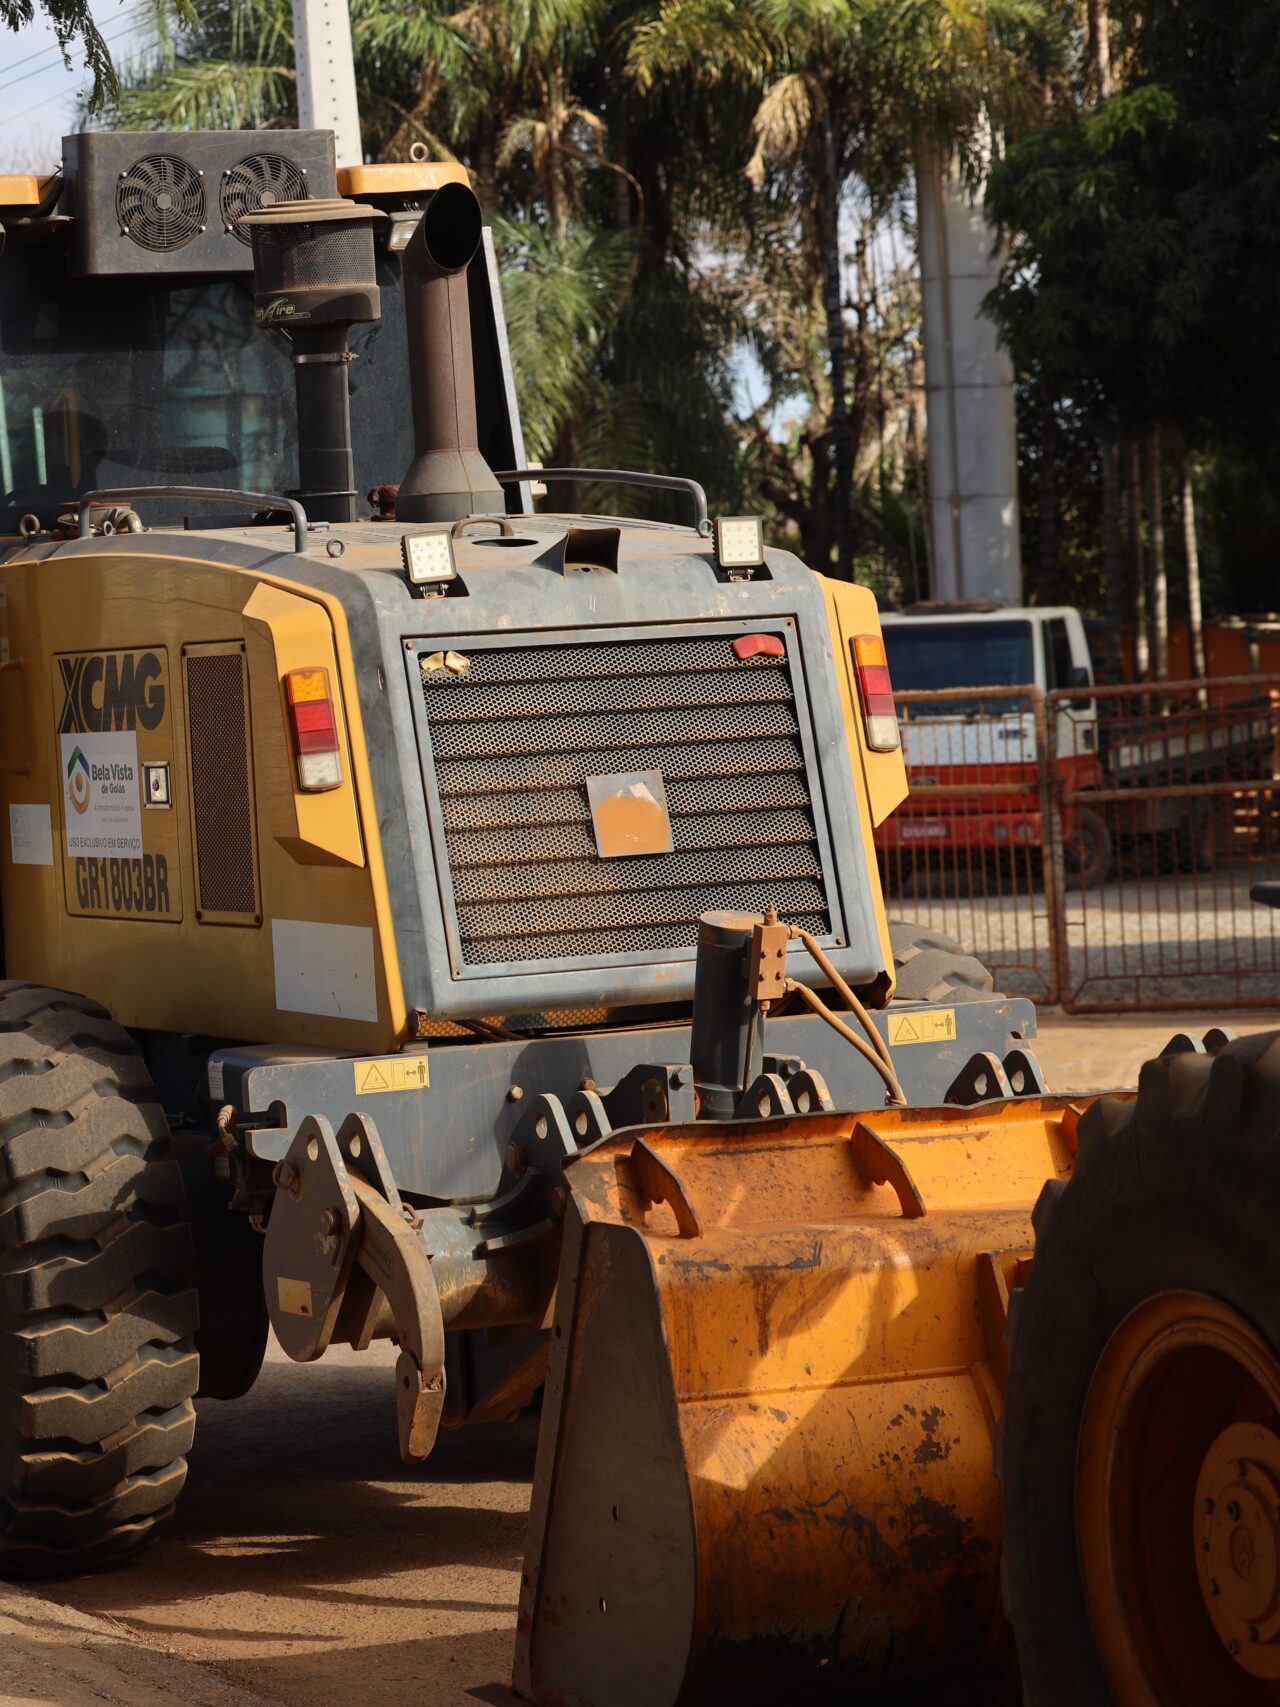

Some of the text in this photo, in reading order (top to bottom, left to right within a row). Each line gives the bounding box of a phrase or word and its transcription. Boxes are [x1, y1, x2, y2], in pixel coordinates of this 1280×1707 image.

[56, 653, 166, 733] XCMG
[91, 763, 133, 780] Bela Vista
[101, 783, 125, 794] de Goiás
[69, 837, 140, 851] USO EXCLUSIVO EM SERVIÇO
[75, 854, 170, 912] GR1803BR
